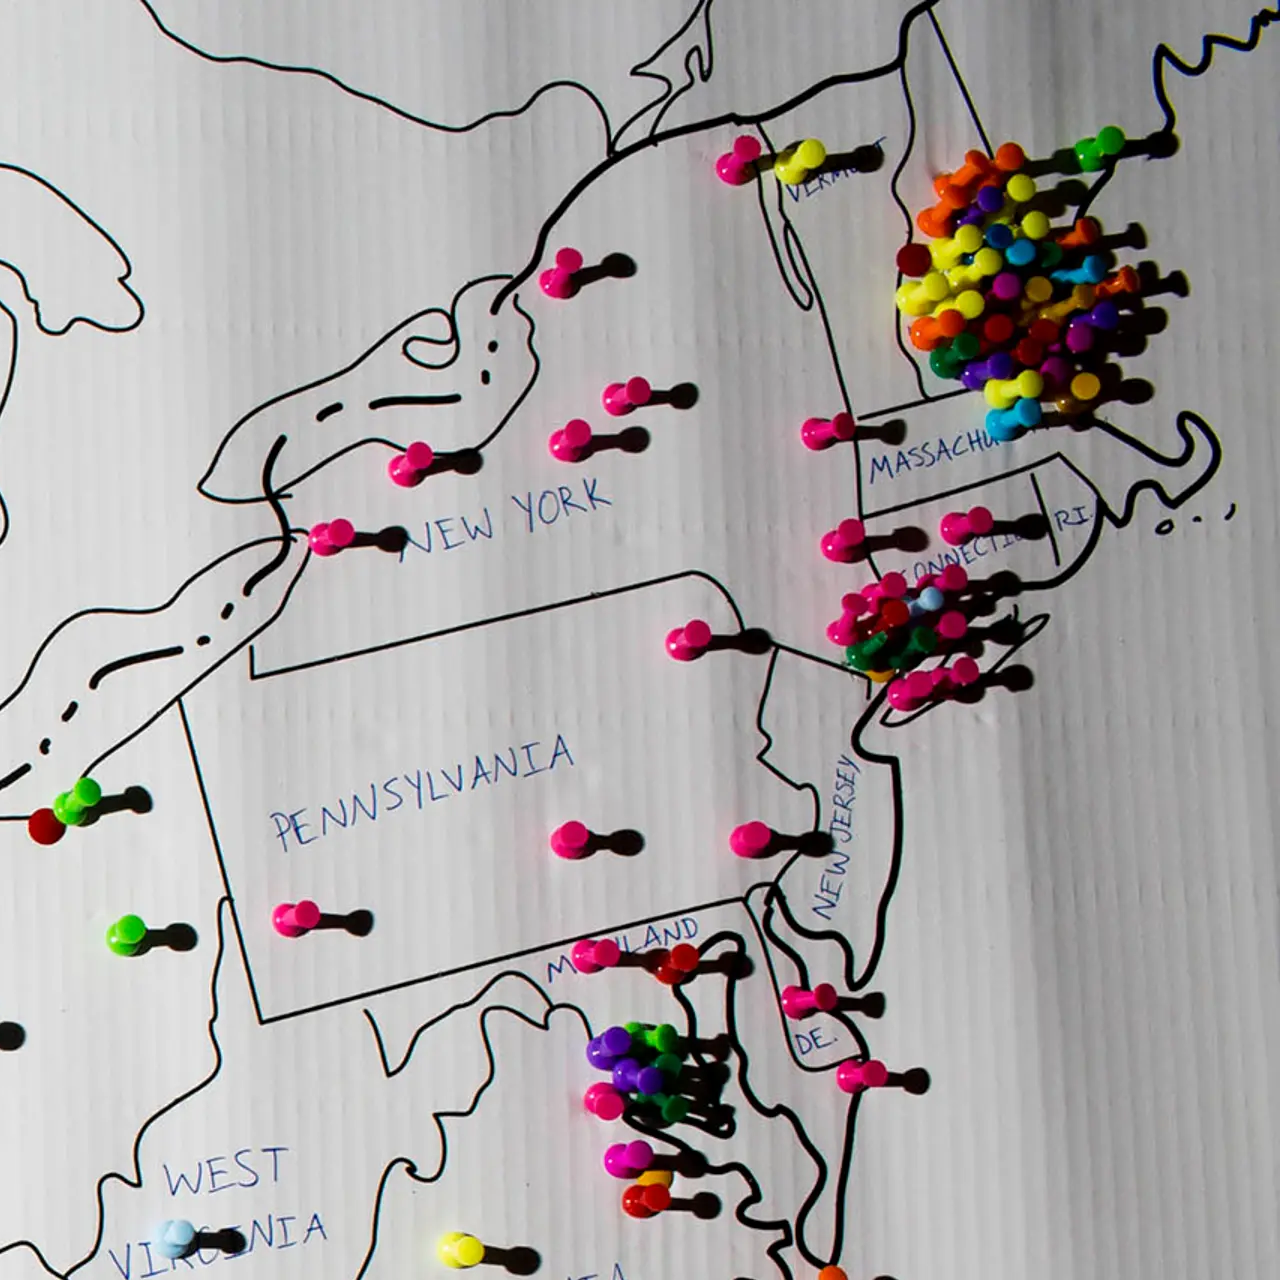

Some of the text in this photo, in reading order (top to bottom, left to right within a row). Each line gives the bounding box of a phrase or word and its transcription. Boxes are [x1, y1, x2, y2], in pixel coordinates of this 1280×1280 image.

[399, 477, 613, 563] NEW YORK
[269, 734, 576, 853] PENNSYLVANIA
[811, 754, 861, 921] NEW JERSEY
[547, 917, 699, 983] MLAND
[163, 1147, 289, 1196] WEST
